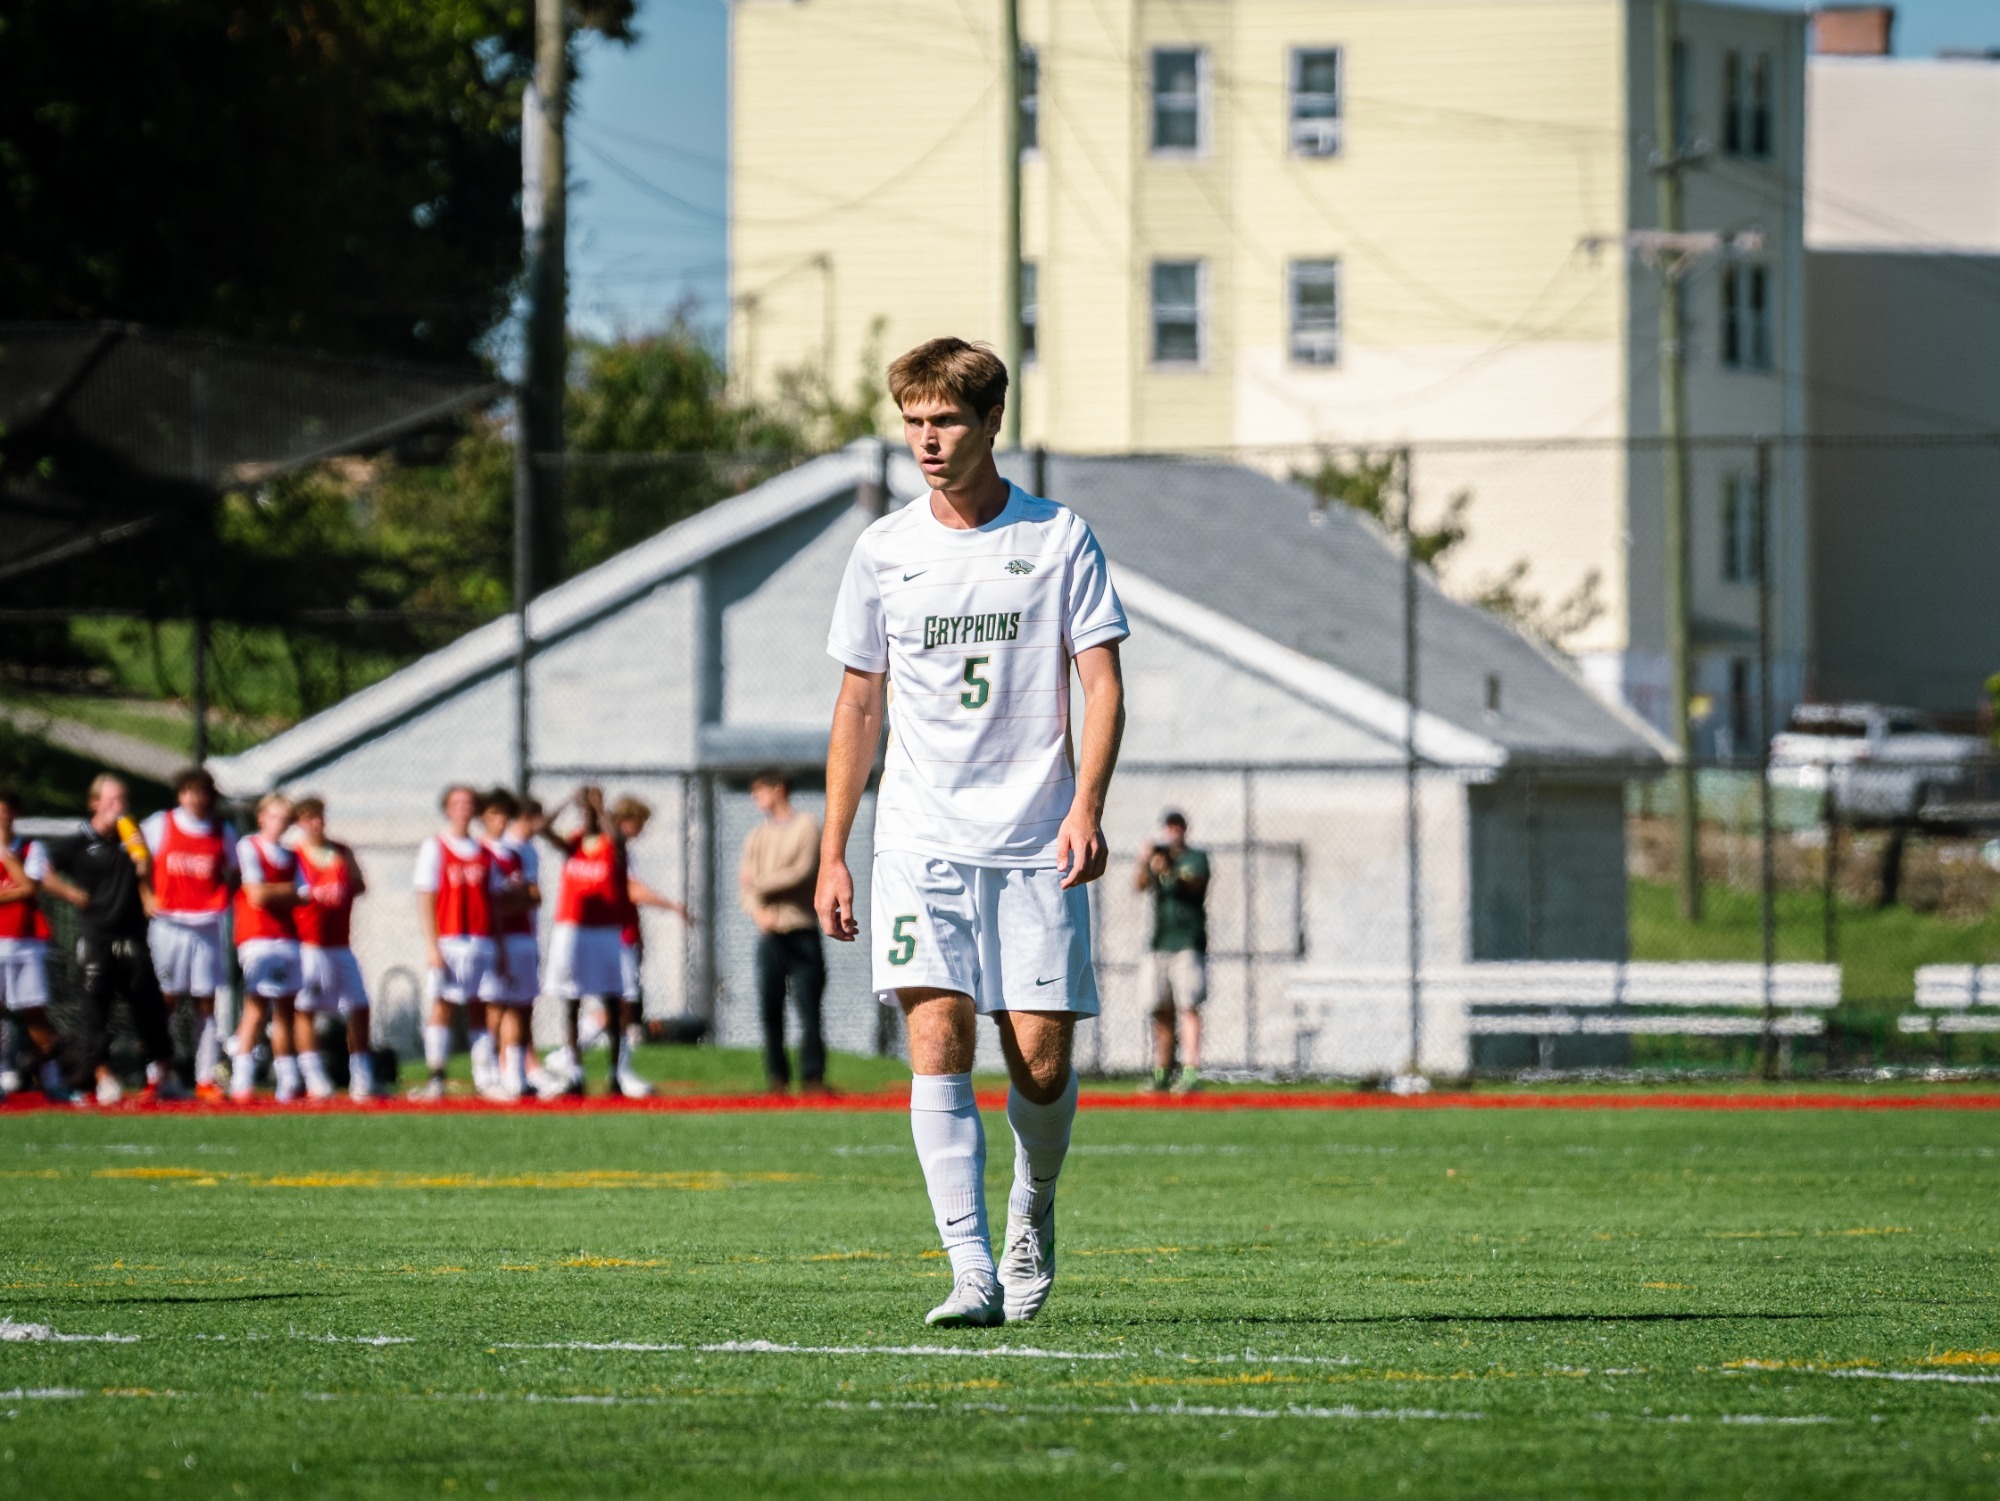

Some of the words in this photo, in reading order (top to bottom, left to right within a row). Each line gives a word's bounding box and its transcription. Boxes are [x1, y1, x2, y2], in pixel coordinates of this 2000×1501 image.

[924, 611, 1022, 649] GRYPHONS
[959, 655, 991, 711] 5
[887, 914, 918, 967] 5
